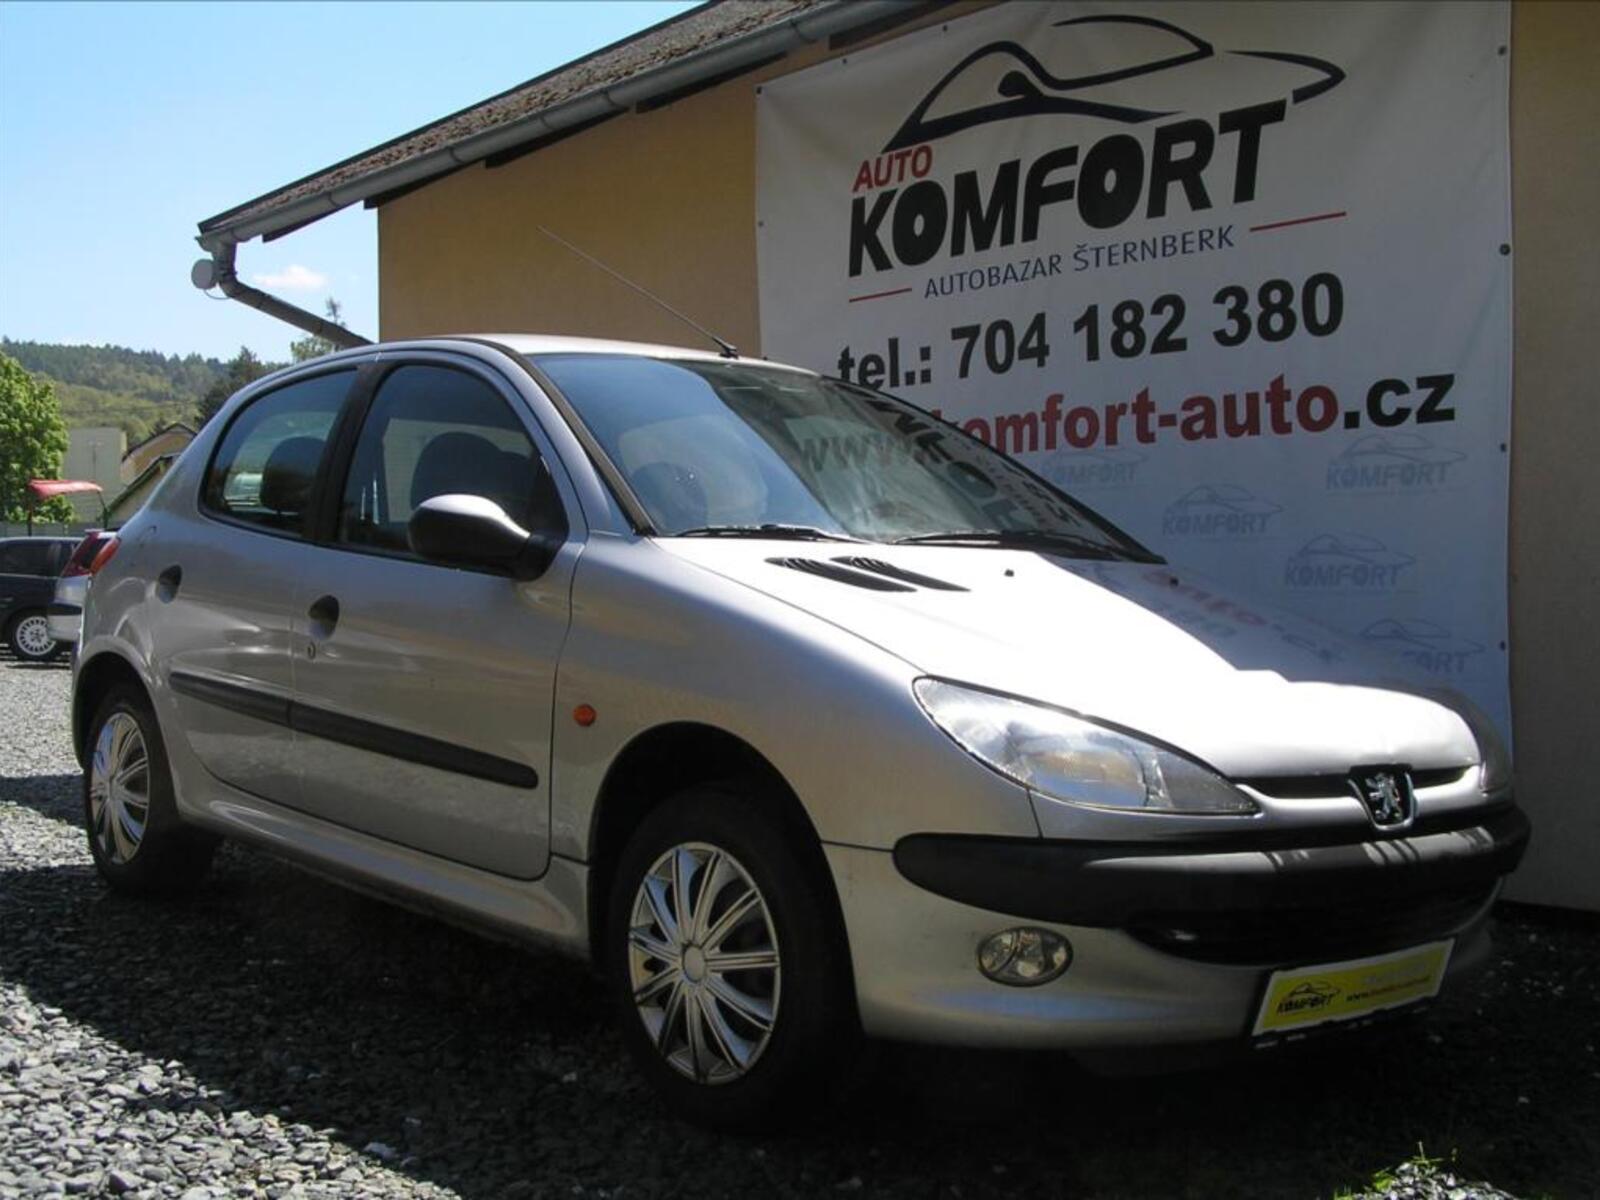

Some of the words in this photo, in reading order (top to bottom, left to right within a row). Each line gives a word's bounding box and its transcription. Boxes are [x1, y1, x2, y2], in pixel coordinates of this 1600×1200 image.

[848, 100, 1287, 278] KOMFORT
[853, 144, 933, 193] AUTO
[924, 253, 1062, 299] AUTOBAZAR
[1073, 224, 1235, 272] ŠTERNBERK
[837, 337, 932, 389] tel.:
[951, 312, 1050, 379] 704
[1073, 293, 1187, 362] 182
[1213, 272, 1344, 348] 380
[931, 372, 1455, 455] omfort-auto.cz
[1326, 460, 1450, 490] KOMFORT
[1162, 512, 1271, 536] KOMFORT
[1284, 563, 1402, 588] KOMFORT
